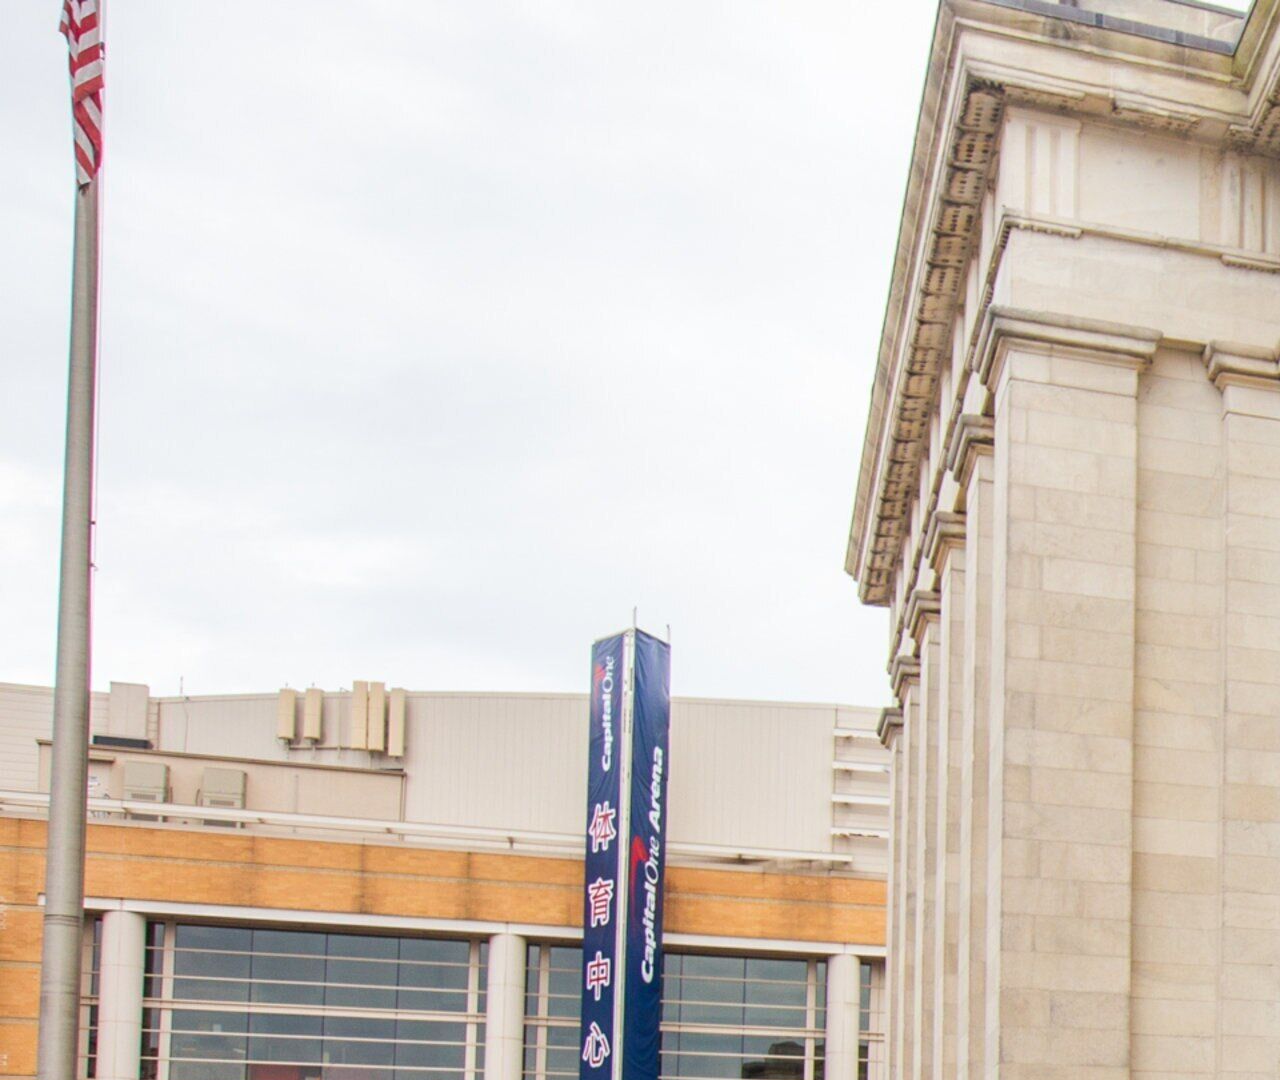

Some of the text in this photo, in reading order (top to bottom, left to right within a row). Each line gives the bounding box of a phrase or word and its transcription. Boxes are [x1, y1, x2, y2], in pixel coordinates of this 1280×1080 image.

[650, 746, 664, 832] Arena
[583, 802, 616, 1067] 体育中心
